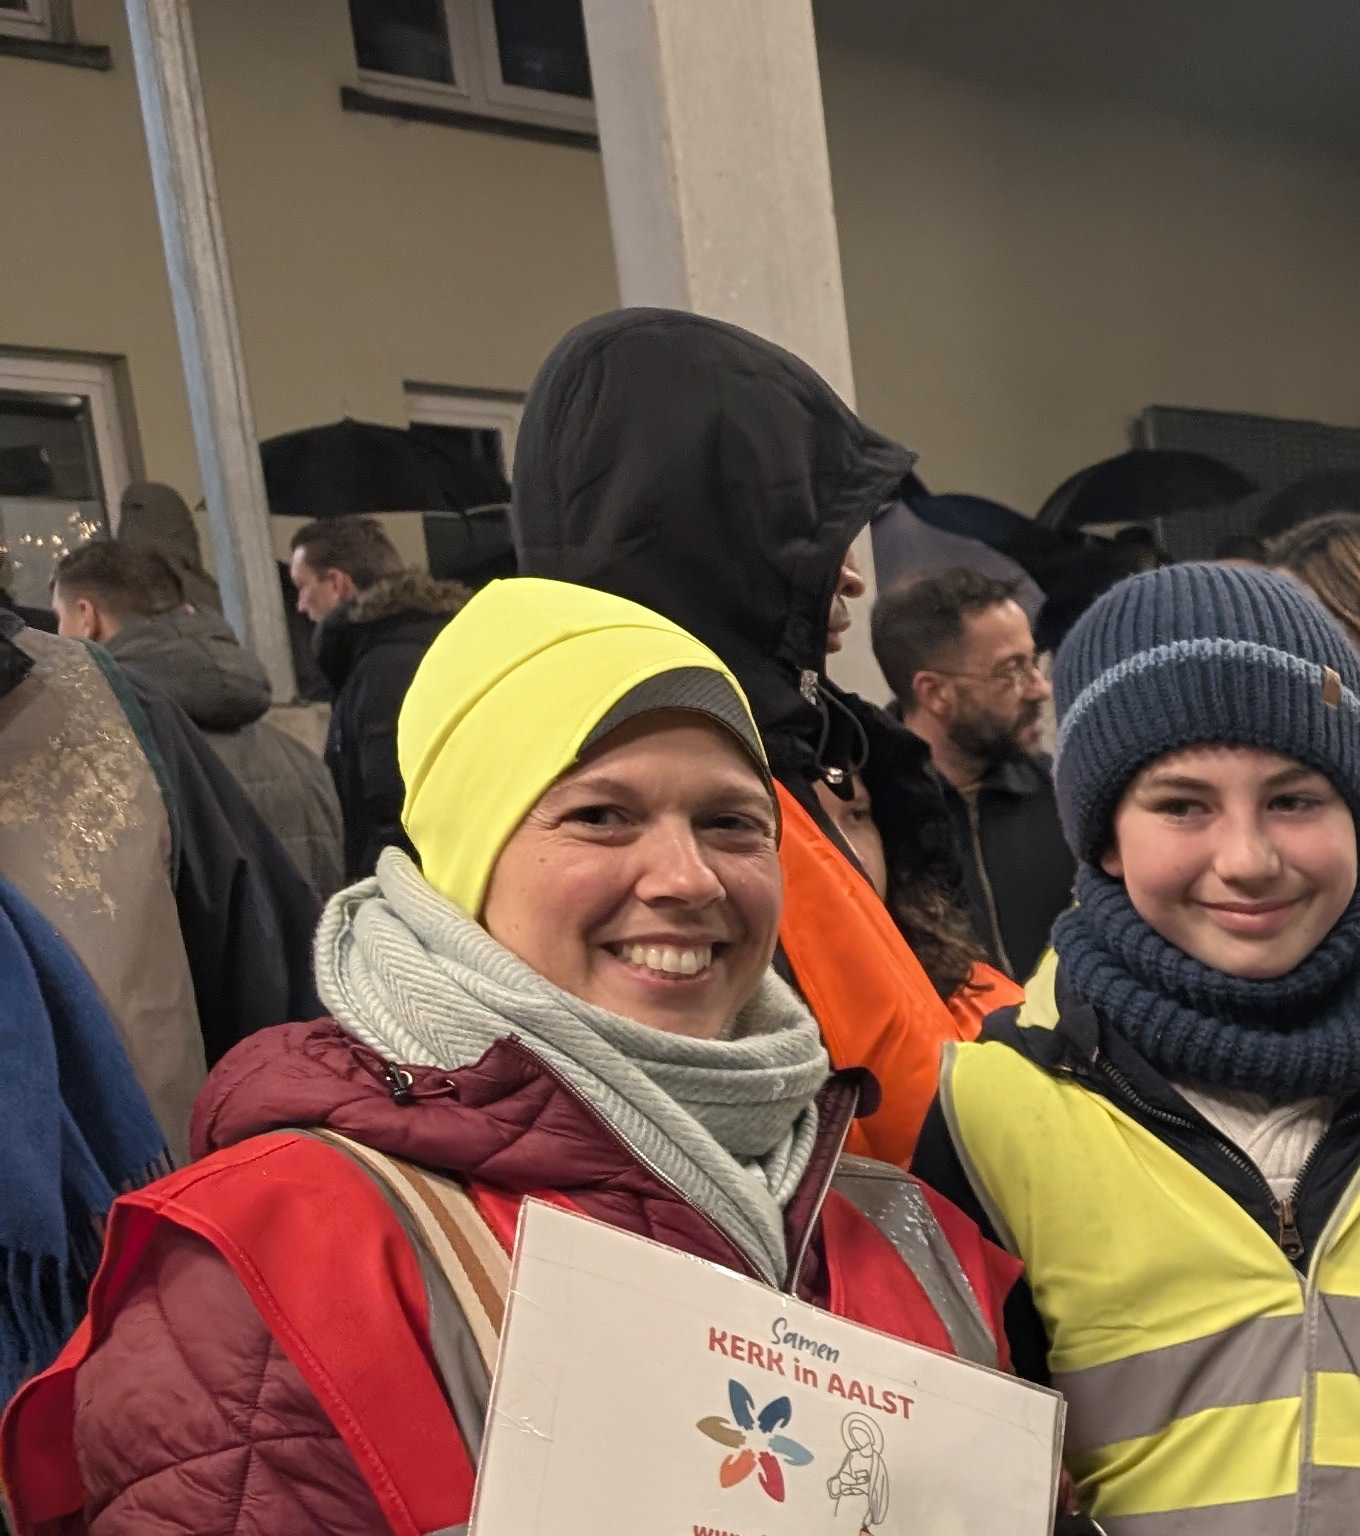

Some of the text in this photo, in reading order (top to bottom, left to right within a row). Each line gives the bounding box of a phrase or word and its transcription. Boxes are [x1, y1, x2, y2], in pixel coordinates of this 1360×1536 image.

[708, 1327, 915, 1419] KERK in AALST
[771, 1317, 840, 1363] Samen
